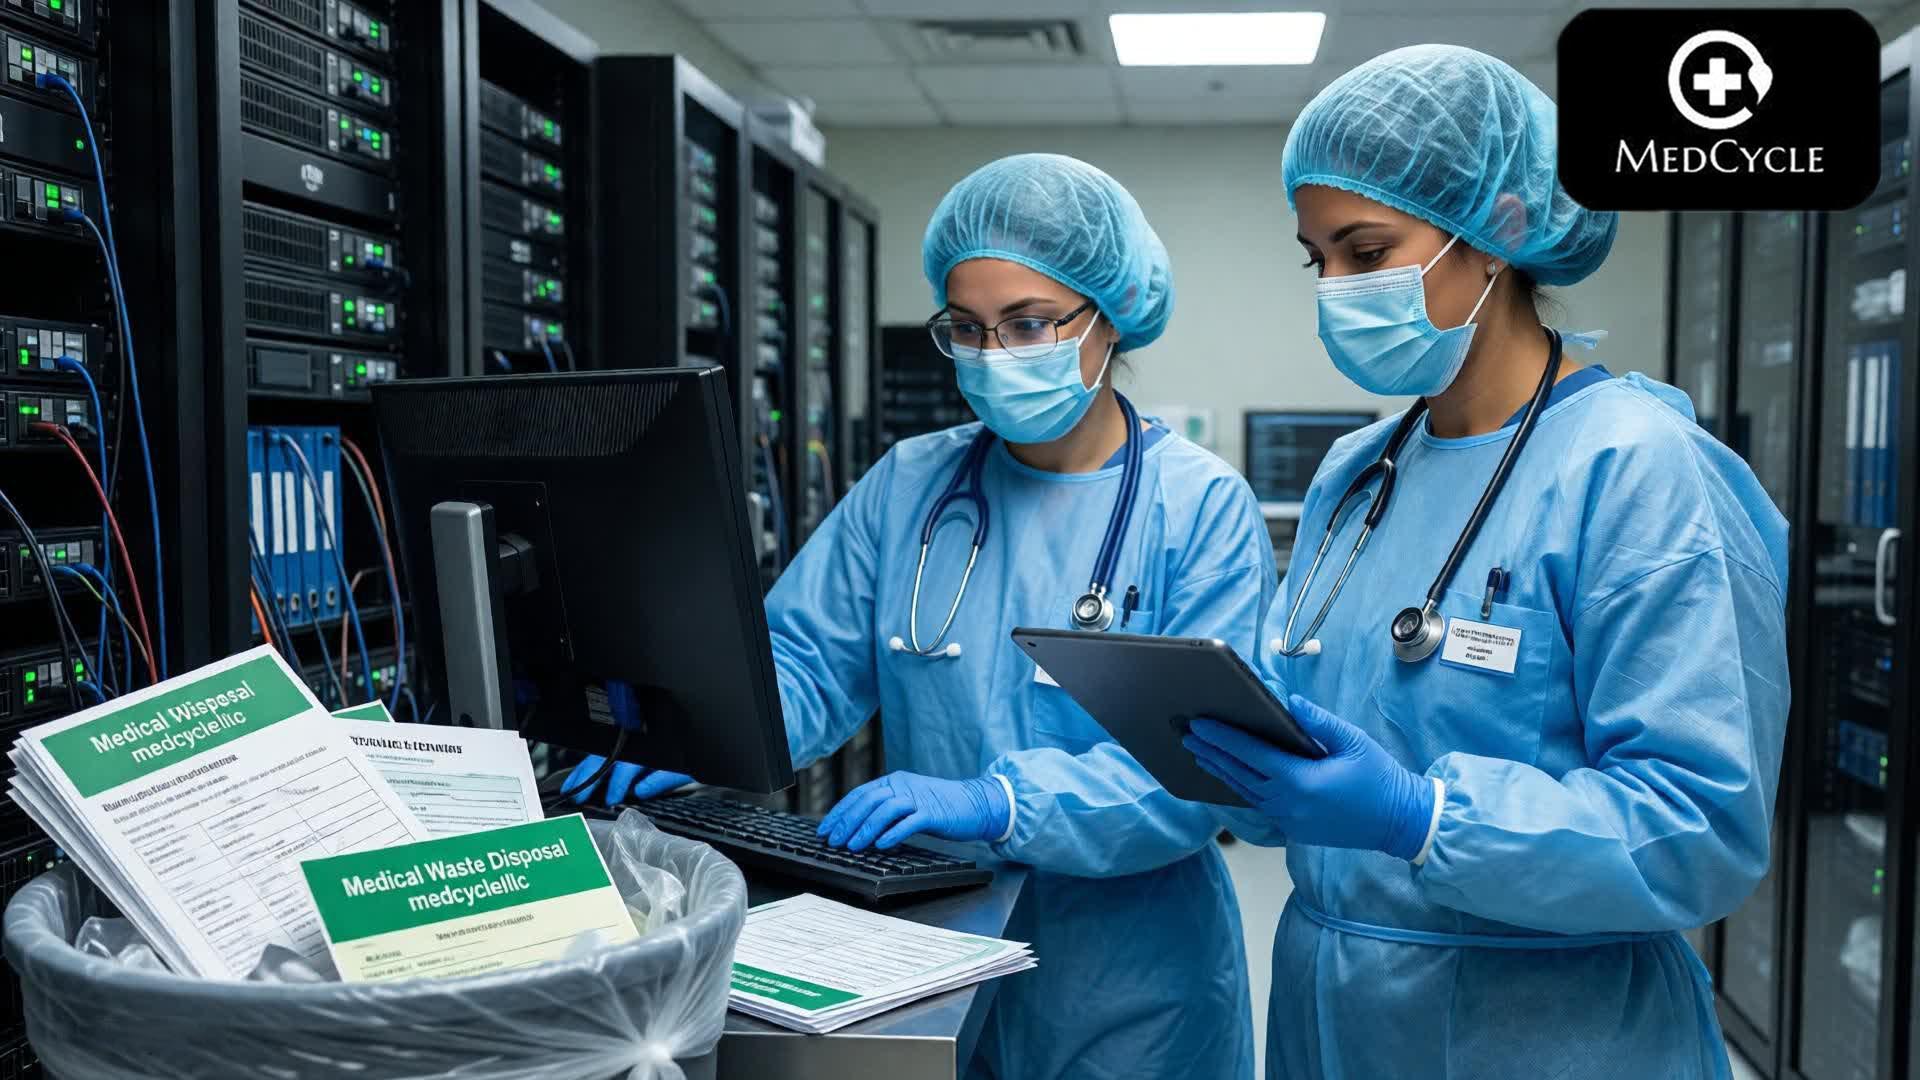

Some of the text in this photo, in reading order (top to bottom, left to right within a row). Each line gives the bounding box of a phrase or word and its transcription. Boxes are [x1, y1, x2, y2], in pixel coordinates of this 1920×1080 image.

[90, 711, 171, 754] Medical
[342, 838, 569, 897] Medical Waste Disposal
